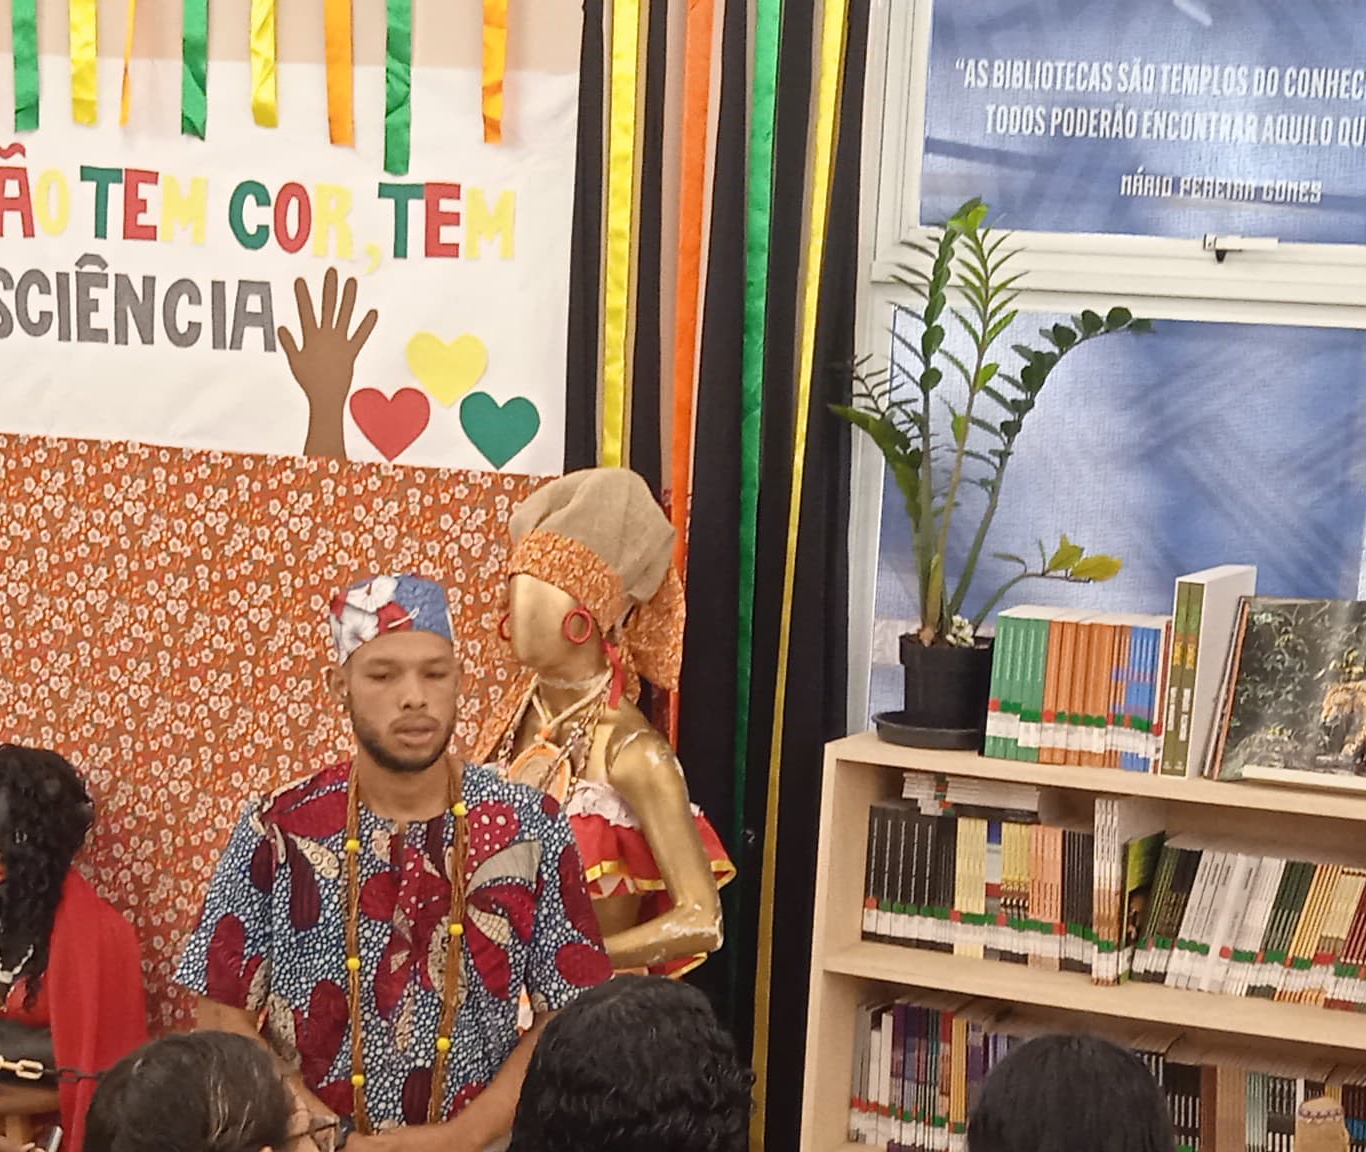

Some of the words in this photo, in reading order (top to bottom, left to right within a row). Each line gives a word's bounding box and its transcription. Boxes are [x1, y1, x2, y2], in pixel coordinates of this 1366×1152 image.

[992, 60, 1113, 93] BIBLIOTECAS
[1117, 58, 1156, 94] SÃO
[1159, 64, 1248, 96] TEMPLOS
[1252, 66, 1280, 98] DO
[985, 103, 1045, 137] TODOS
[1050, 103, 1135, 139] PODERÃO
[1142, 109, 1258, 143] ENCONTRAR
[1262, 113, 1332, 146] AQUILO
[80, 166, 209, 247] TEM
[378, 180, 517, 263] TEM
